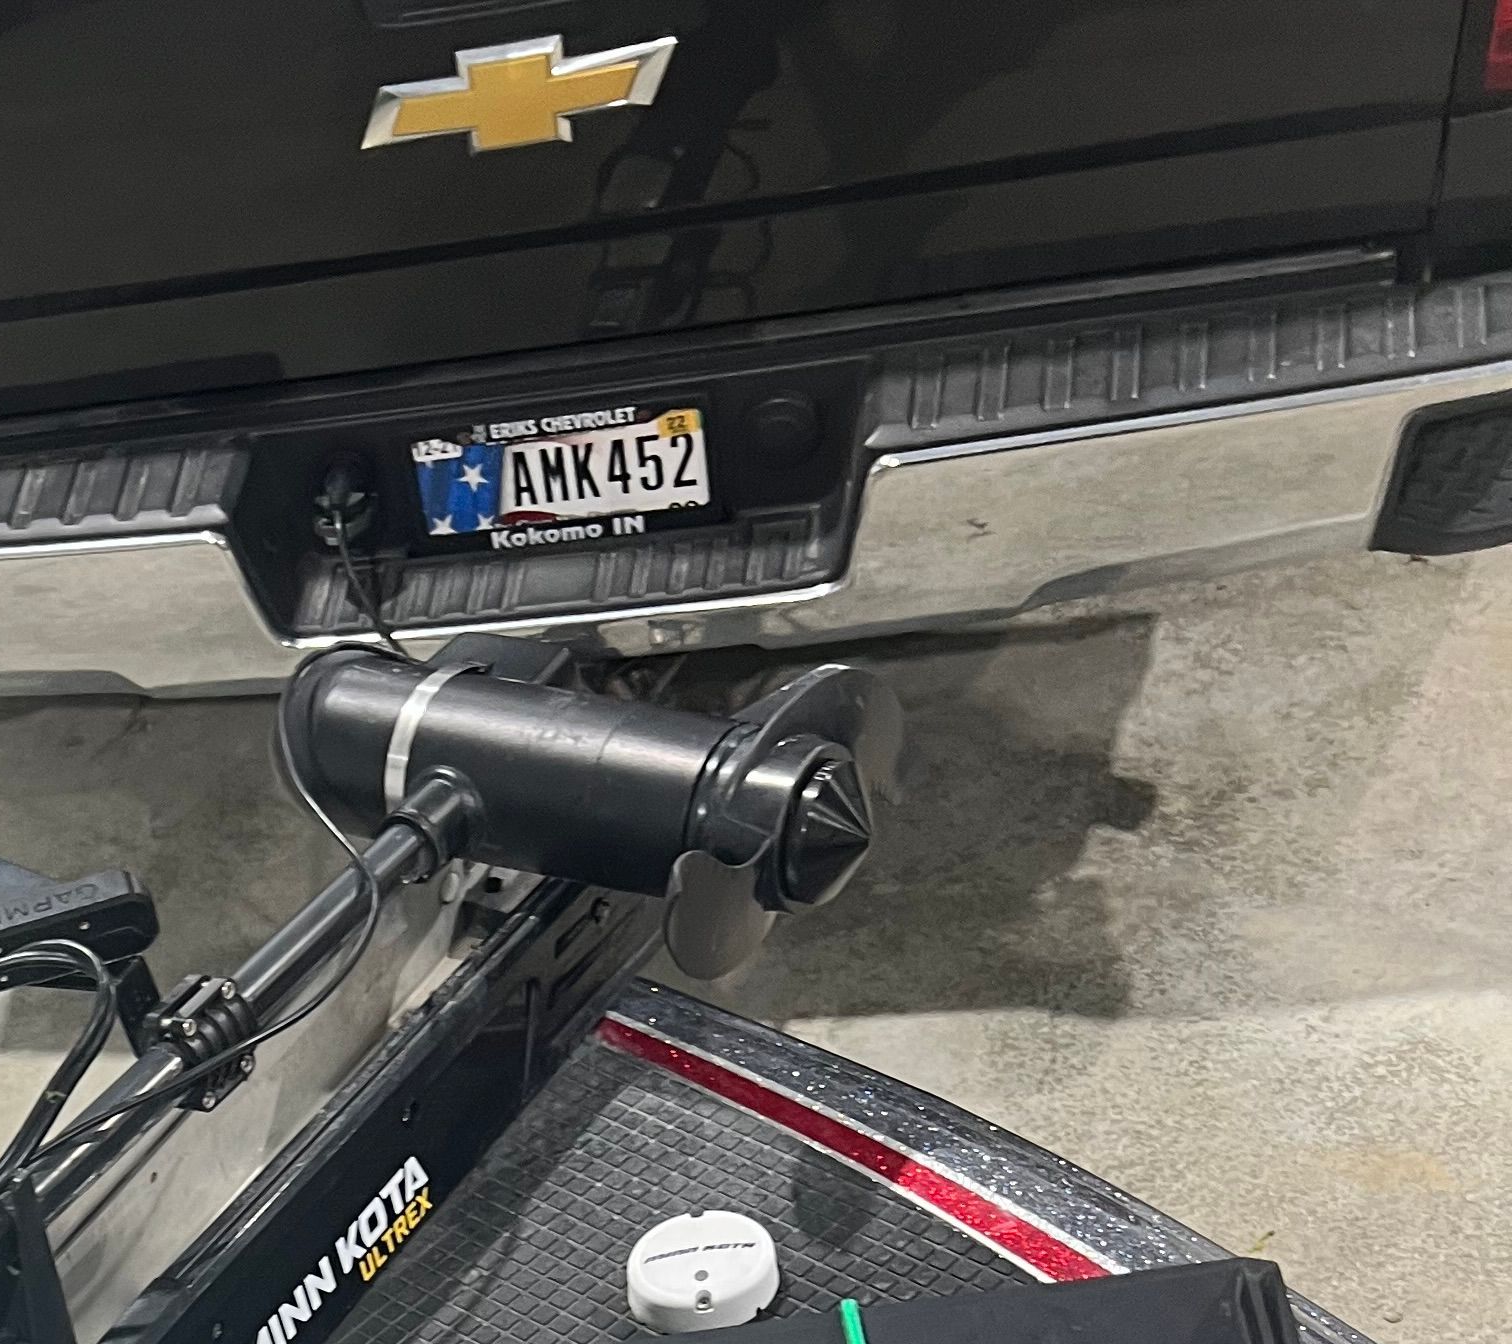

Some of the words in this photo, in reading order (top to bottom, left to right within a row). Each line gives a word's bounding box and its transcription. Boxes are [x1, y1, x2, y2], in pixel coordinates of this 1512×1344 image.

[540, 405, 637, 434] CHEVROLET
[491, 521, 602, 550] Kokomo
[611, 514, 647, 537] IN
[334, 1155, 430, 1275] KOTA
[358, 1186, 433, 1282] ULTREX
